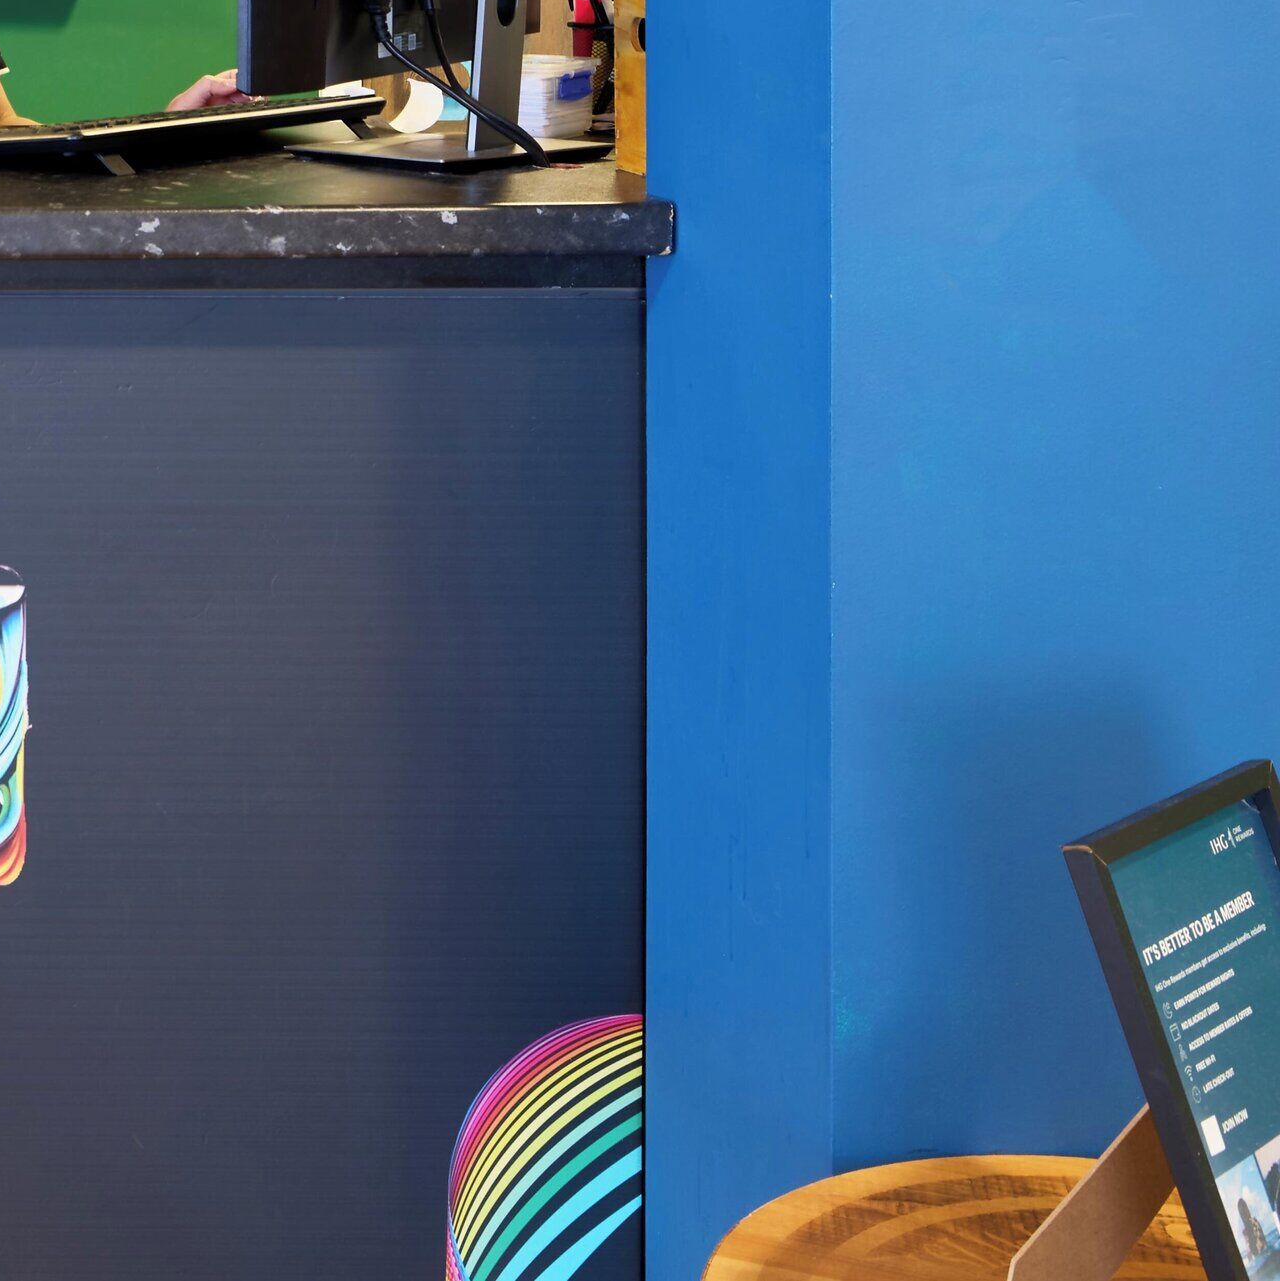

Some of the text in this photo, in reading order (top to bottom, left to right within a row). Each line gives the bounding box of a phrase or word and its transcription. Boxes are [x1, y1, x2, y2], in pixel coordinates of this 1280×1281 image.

[1209, 834, 1229, 855] IHG
[1143, 891, 1254, 966] IT'S BETTER TO BE A MEMBER
[1174, 969, 1234, 1010] EARN POINTS FOR REWARD NIGHTS
[1181, 1002, 1219, 1030] NO BLACKOUT DATES
[1189, 1036, 1205, 1051] ACCESS
[1203, 1033, 1210, 1041] TO
[1209, 1024, 1225, 1038] MEMBER
[1224, 1017, 1236, 1029] RATES
[1238, 1006, 1252, 1020] OFFERS
[1196, 1055, 1216, 1072] FREE WI-FI
[1203, 1068, 1234, 1093] LATE CHECK-OUT
[1222, 1108, 1248, 1134] JOIN NOW
